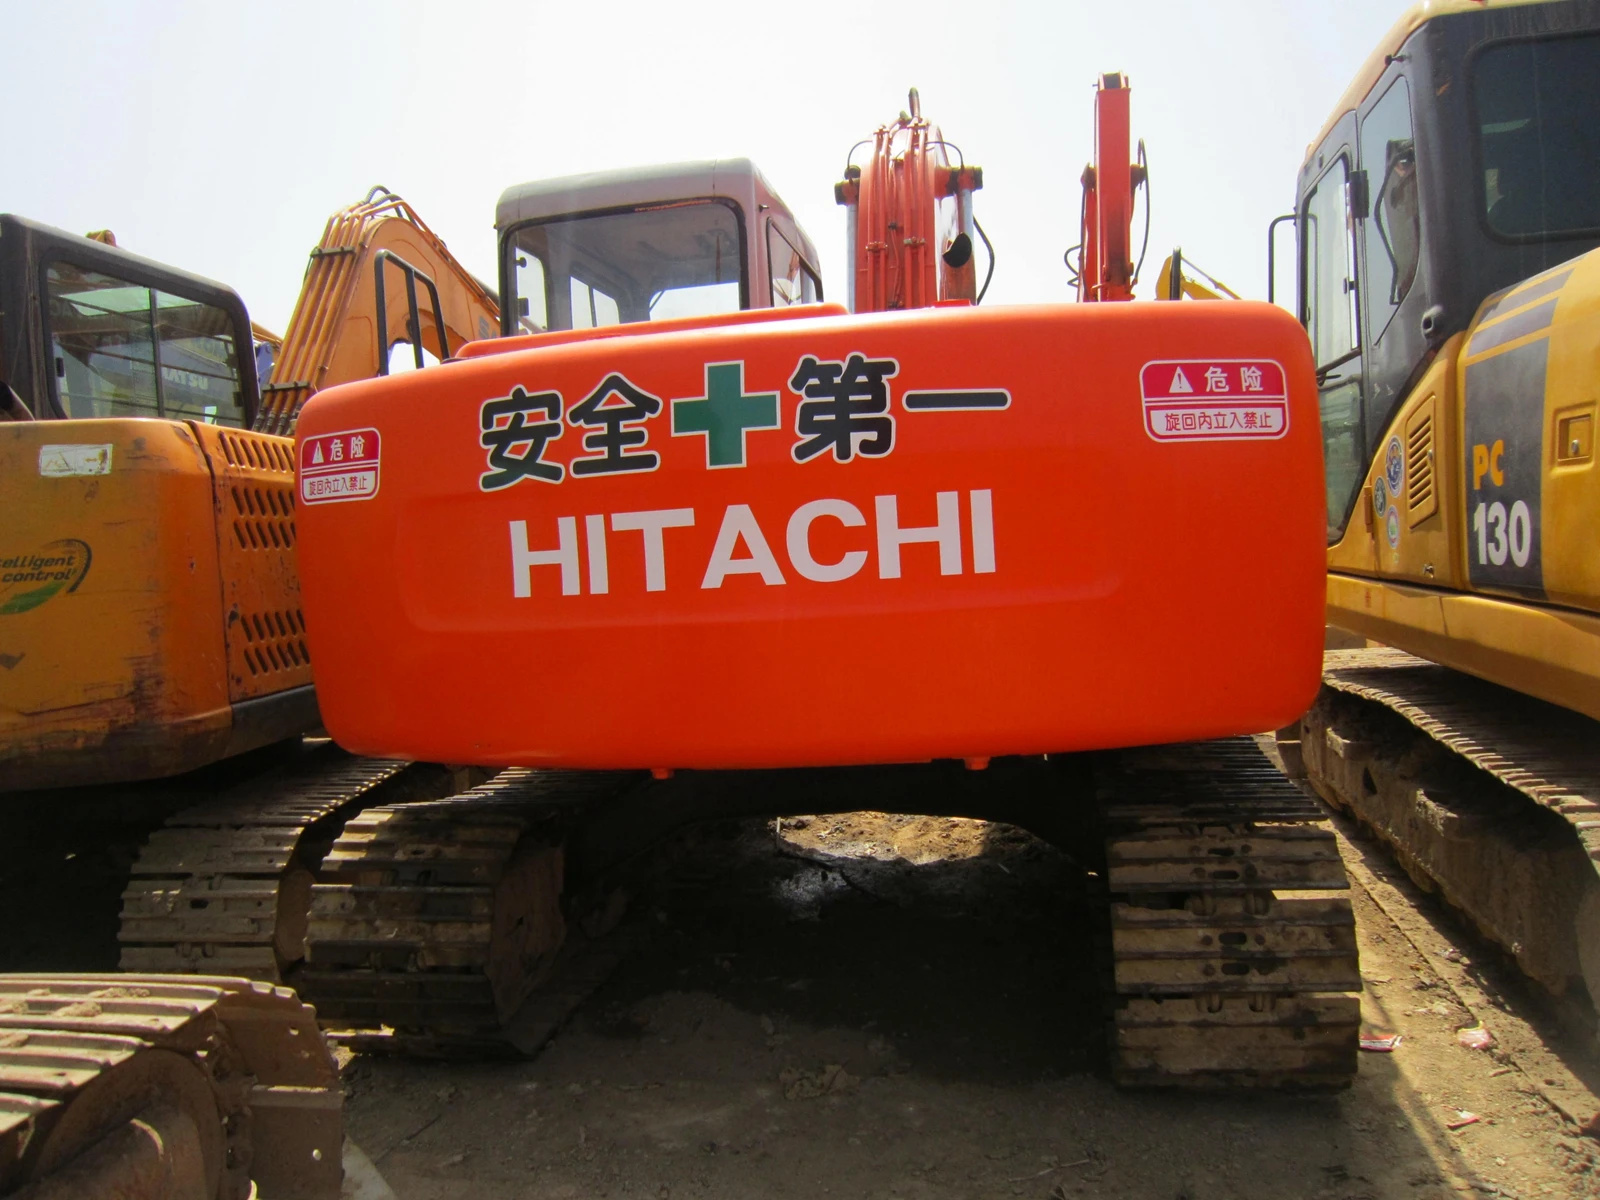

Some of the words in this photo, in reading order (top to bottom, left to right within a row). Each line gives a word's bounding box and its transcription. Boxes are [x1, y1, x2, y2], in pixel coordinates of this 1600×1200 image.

[1204, 366, 1263, 392] 危险
[479, 371, 663, 492] 安全
[788, 352, 1011, 464] 第一
[330, 435, 365, 461] 危险
[1473, 439, 1504, 490] PC
[509, 489, 996, 598] HITACHI
[1473, 500, 1531, 568] 130
[2, 567, 71, 582] control
